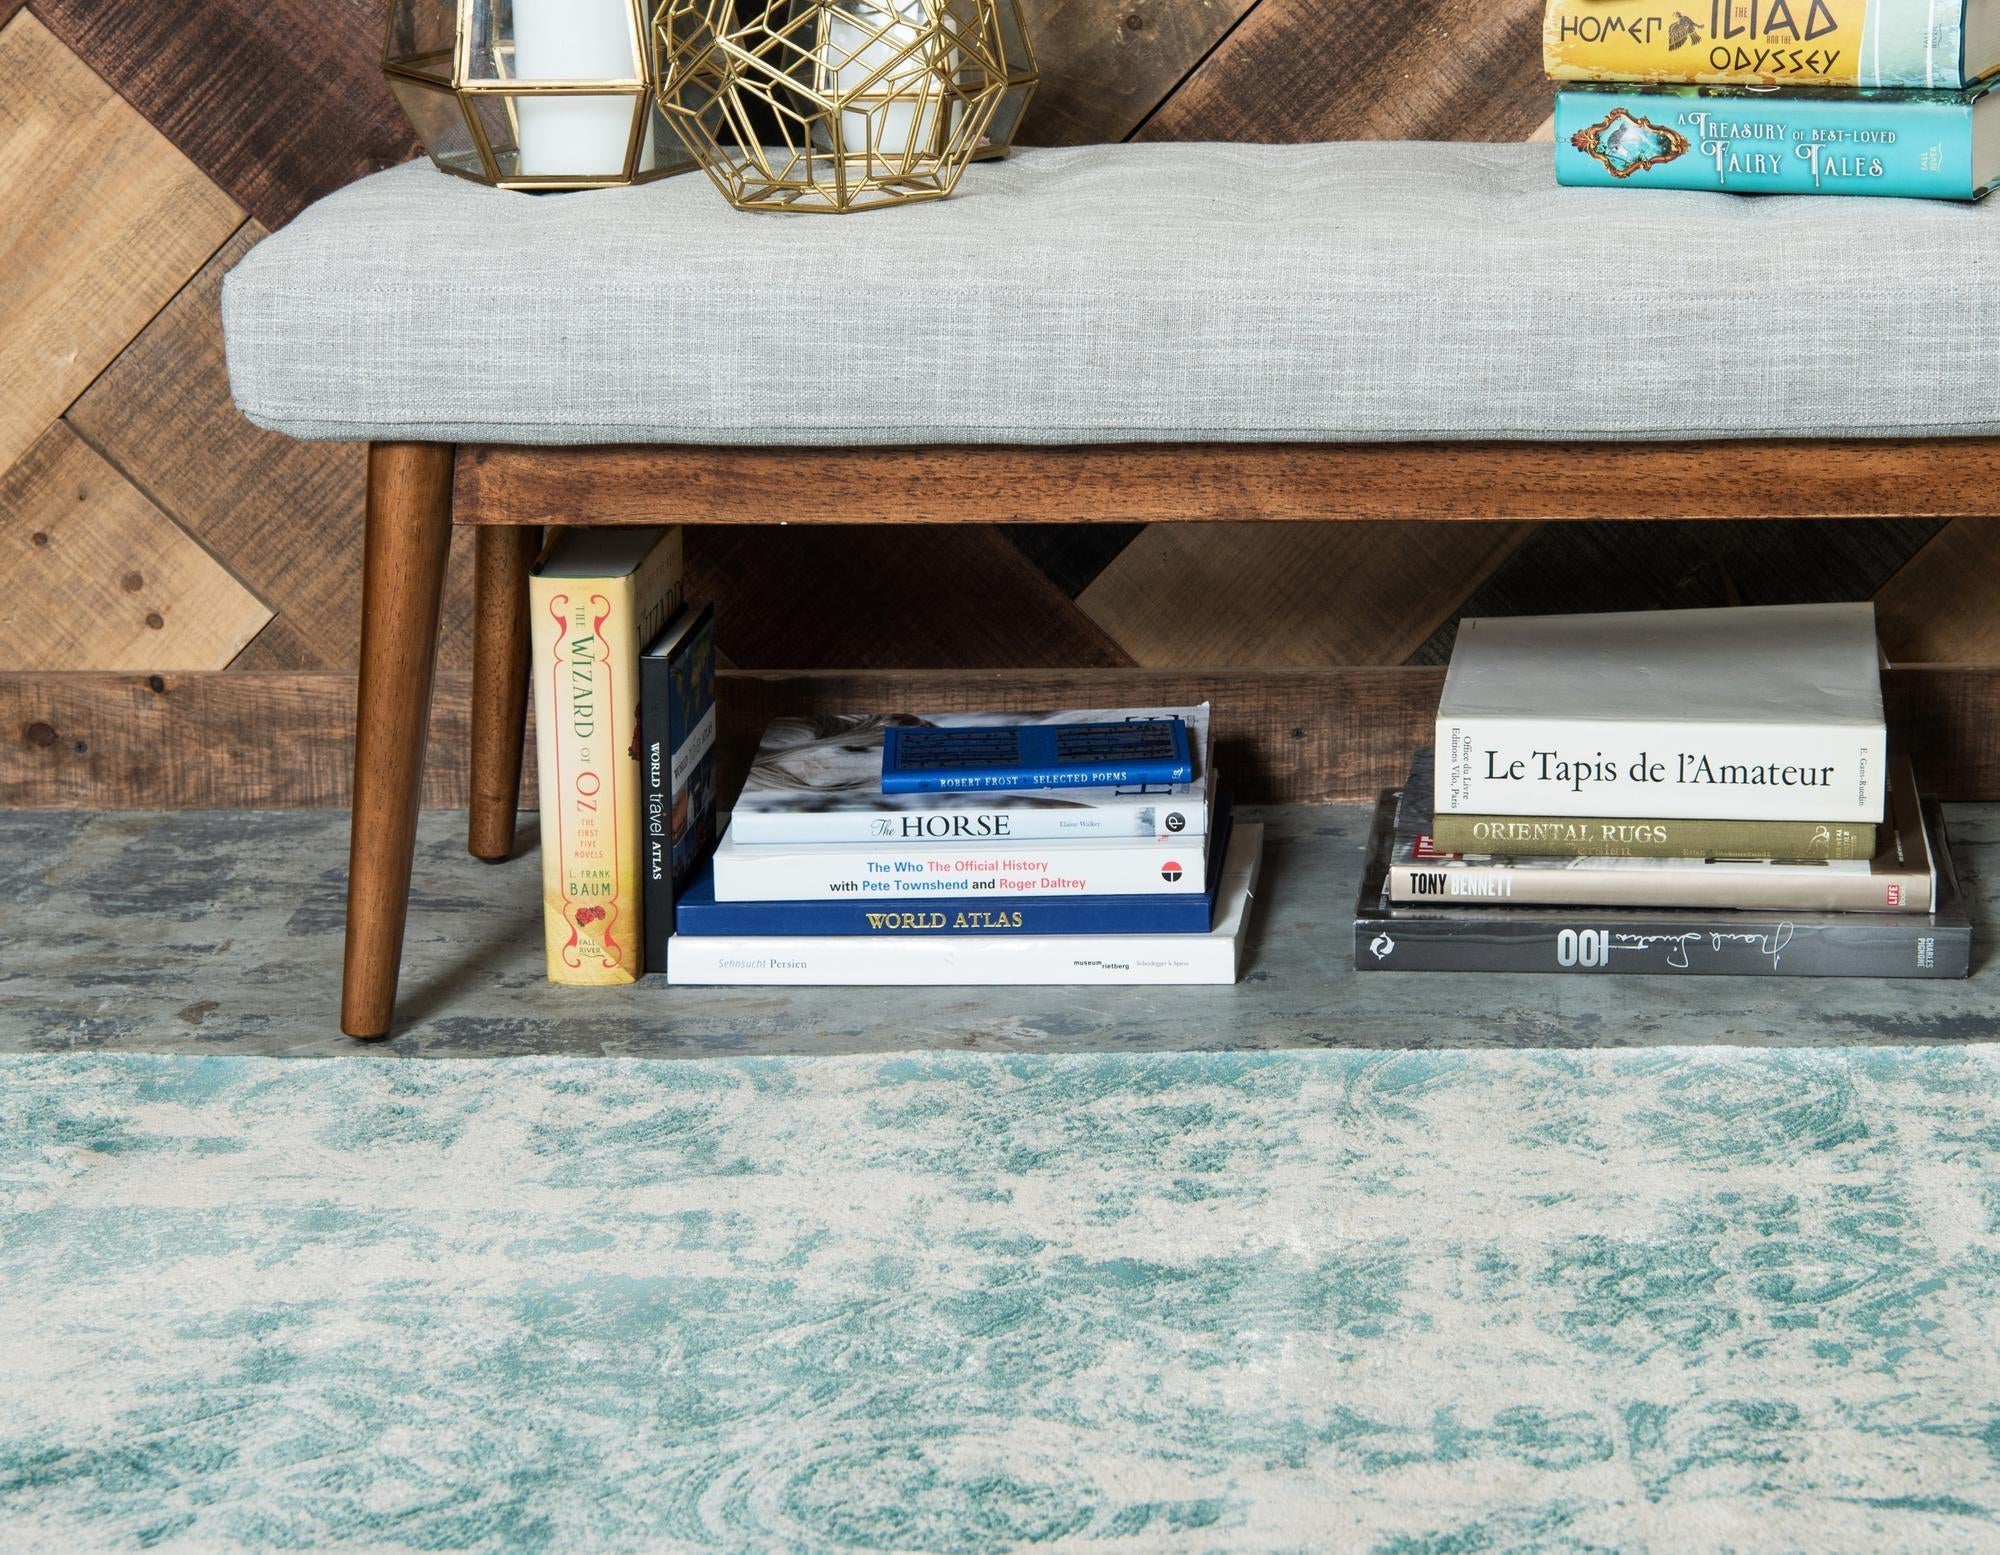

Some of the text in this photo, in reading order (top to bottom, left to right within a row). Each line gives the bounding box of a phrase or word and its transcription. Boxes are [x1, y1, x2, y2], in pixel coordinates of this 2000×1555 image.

[1711, 0, 1838, 41] ILIAD
[1735, 6, 1748, 18] THE
[1710, 46, 1840, 74] ODYSSEY
[1678, 113, 1686, 125] A
[1688, 112, 1787, 141] TREASURY
[1812, 129, 1896, 143] BEST-LOVED
[1701, 140, 1883, 187] FAIRY TALES
[575, 605, 586, 628] THE
[571, 633, 596, 738] WIZARD
[1451, 727, 1460, 763] Editions
[1462, 735, 1472, 800] Office du Livre
[1484, 750, 1835, 792] Le Tapis de l’Amateur
[940, 772, 1127, 788] ROBERT FROST SELECTED POEMS
[575, 772, 600, 812] OZ
[1451, 788, 1459, 809] Paris
[649, 741, 666, 880] WORLD travel ATLAS
[577, 829, 599, 837] FIRST
[581, 818, 595, 826] THE
[870, 815, 1011, 837] The HORSE
[1473, 822, 1668, 844] ORIENTAL RUGS
[574, 851, 604, 859] NOVELS
[581, 870, 611, 878] FRANK
[867, 860, 1048, 873] The Who The Official History
[570, 883, 611, 896] BAUM
[829, 877, 1086, 892] with Pete Townshend and Roger Daltrey
[1410, 873, 1447, 895] TONY
[1451, 873, 1513, 896] BENNETT
[1888, 885, 1899, 905] LIFE
[866, 912, 1022, 929] WORLD ATLAS
[718, 958, 807, 968] Sehnsucht Persien
[1917, 938, 1925, 968] PIGNONE
[1926, 938, 1934, 969] CHARLES
